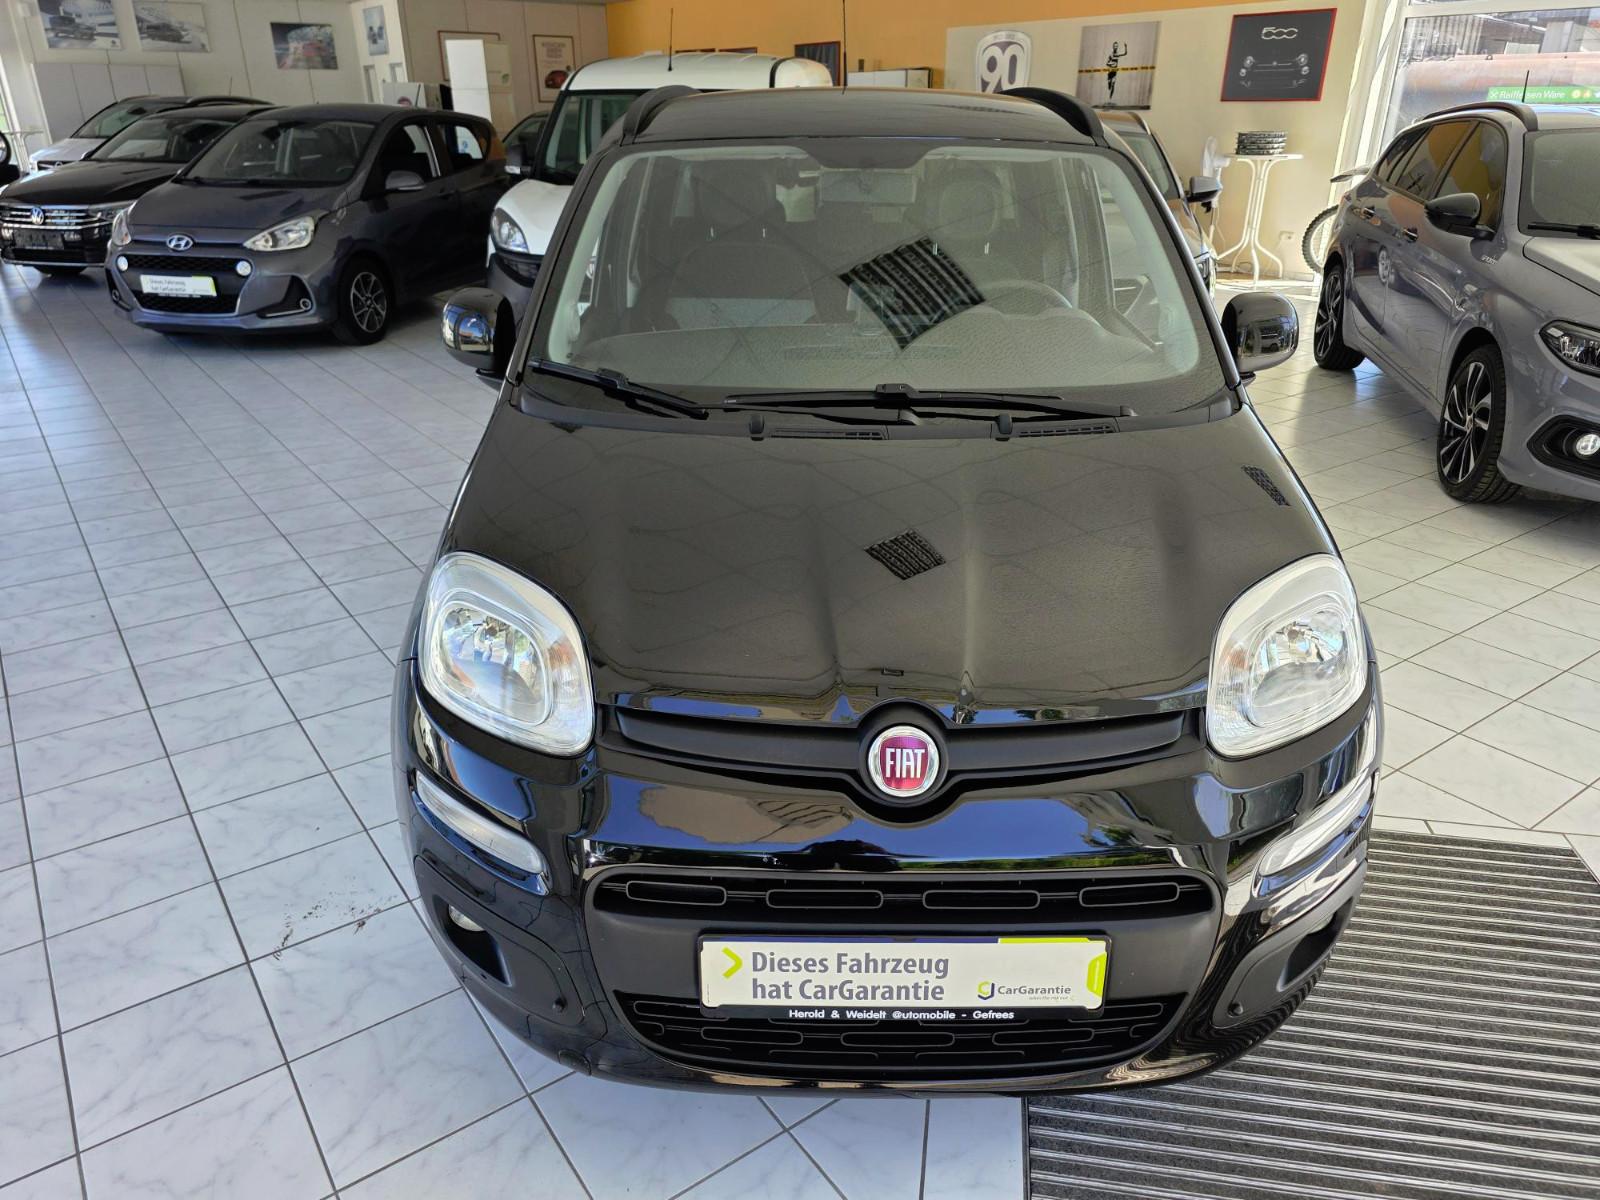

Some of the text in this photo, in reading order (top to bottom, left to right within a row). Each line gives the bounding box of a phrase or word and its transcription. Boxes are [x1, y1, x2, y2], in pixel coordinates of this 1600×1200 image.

[1261, 27, 1298, 40] 500
[1499, 90, 1542, 99] Raiffesen
[885, 747, 925, 778] FIAT
[752, 951, 949, 979] Dieses Fahrzeug
[752, 978, 945, 1001] hat CarGarantie
[997, 985, 1072, 995] CarGarantie
[789, 1009, 825, 1019] Herold
[831, 1010, 840, 1019] &
[846, 1010, 887, 1019] Weidelt
[892, 1010, 956, 1020] @utomobile
[972, 1010, 1015, 1019] Gefrees
